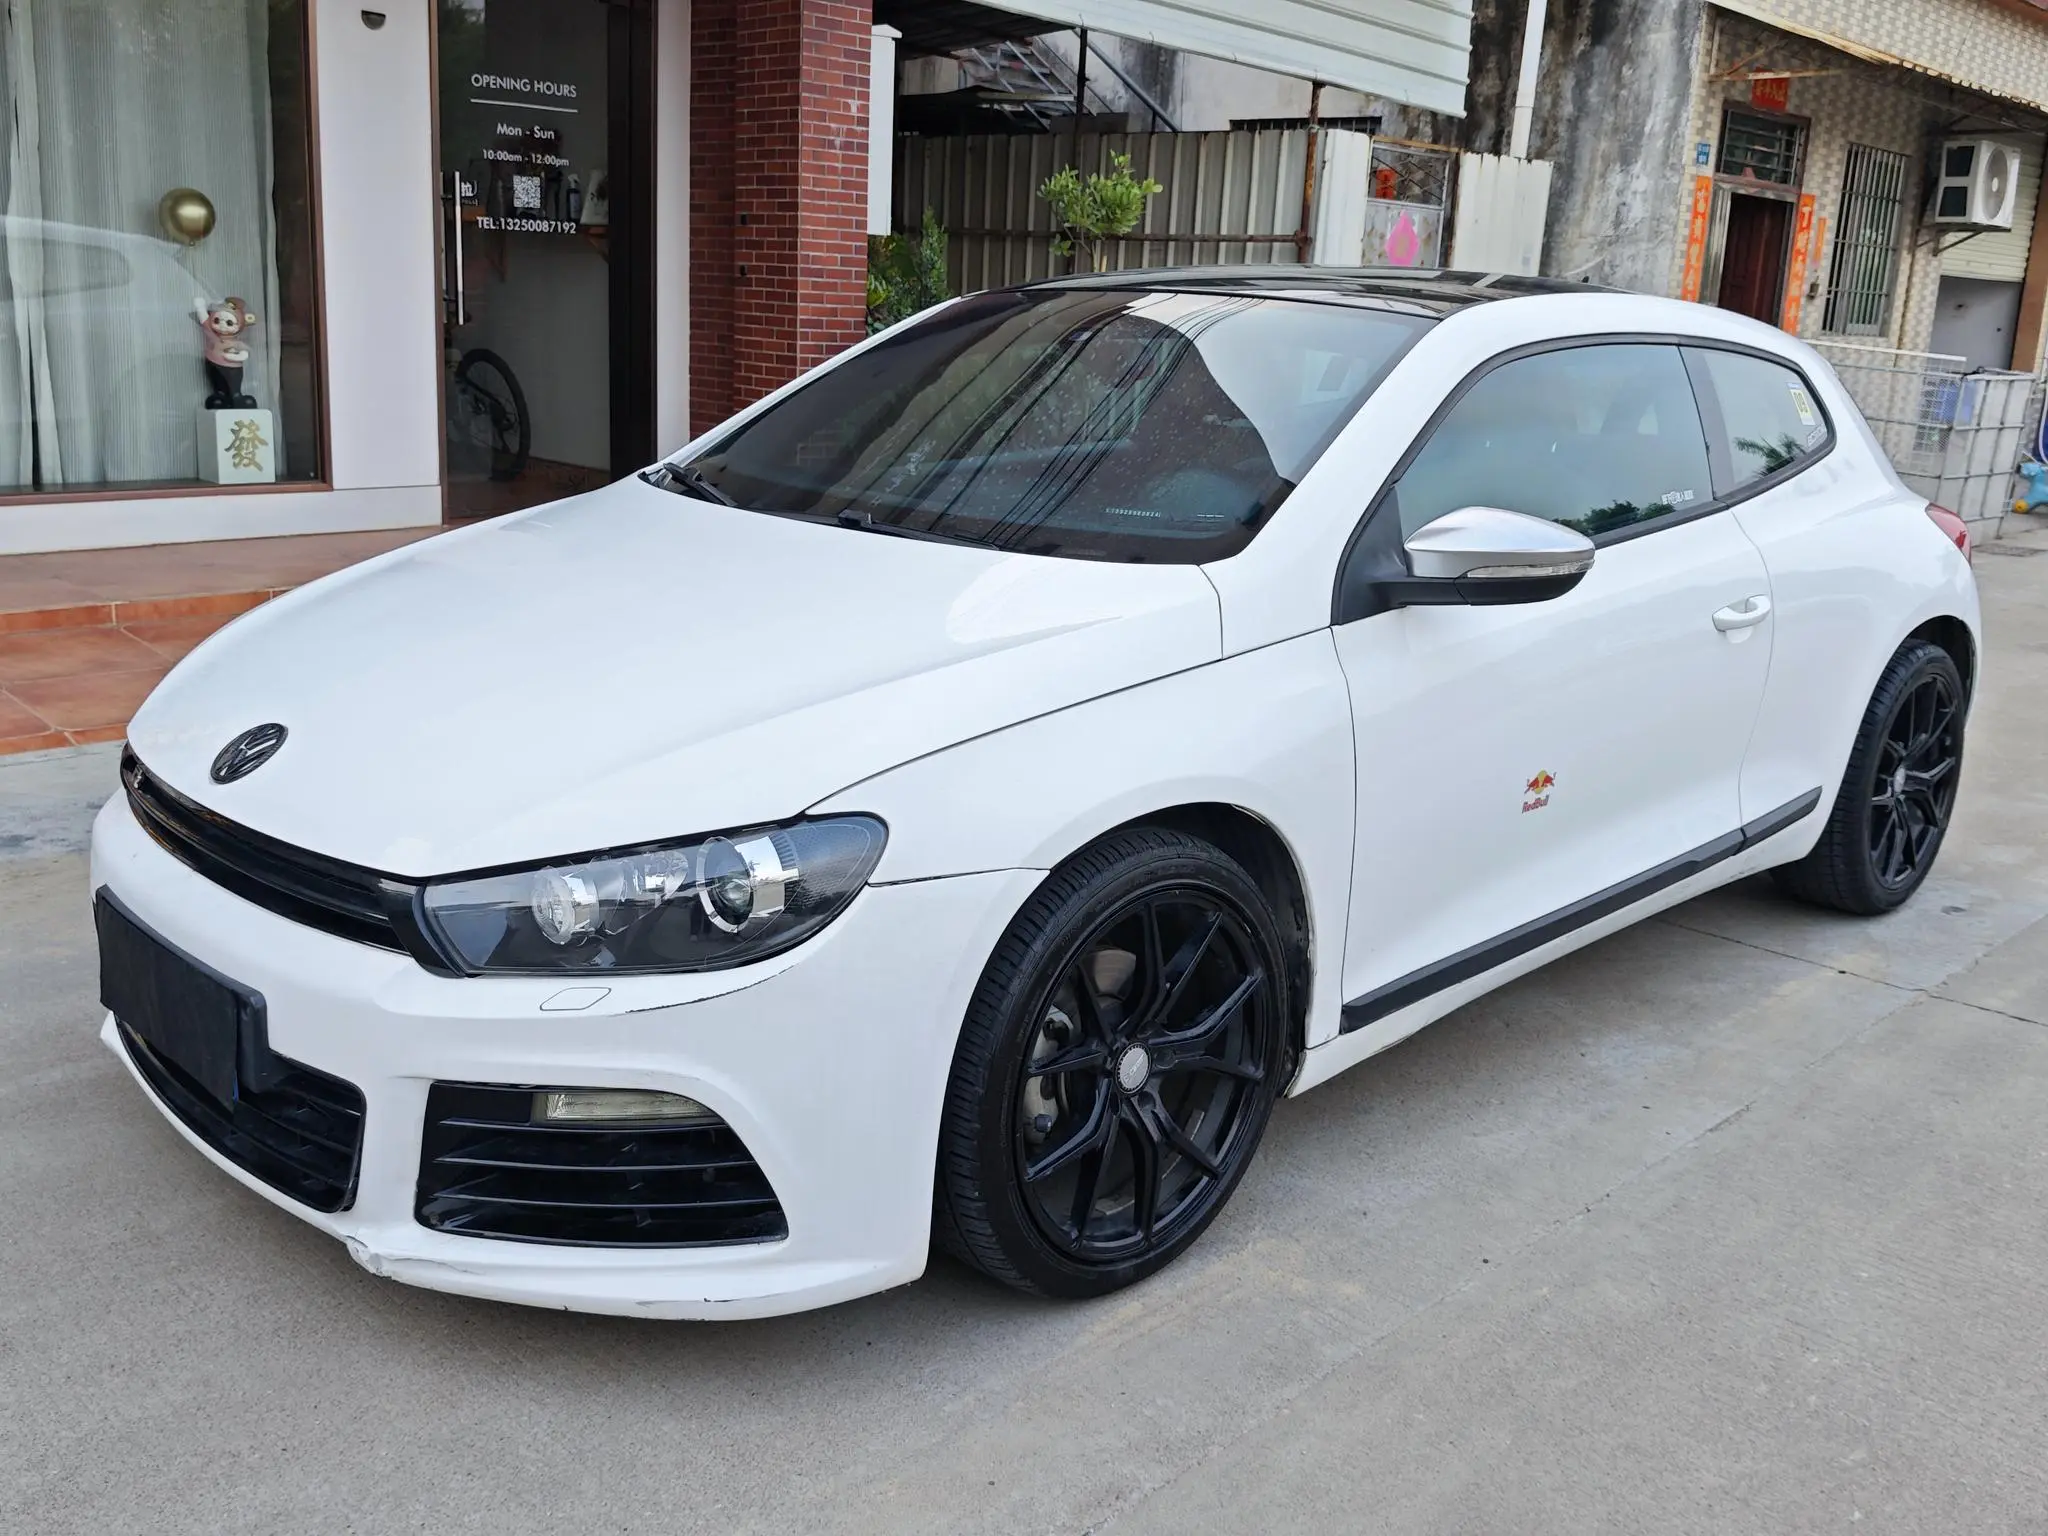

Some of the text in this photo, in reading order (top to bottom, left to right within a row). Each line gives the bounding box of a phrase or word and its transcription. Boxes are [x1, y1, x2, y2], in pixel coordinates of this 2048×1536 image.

[471, 74, 577, 98] OPENING HOURS
[496, 123, 522, 137] Mon
[533, 125, 555, 140] Sun
[482, 149, 522, 163] 10:00am
[531, 153, 570, 167] 12:00pm
[477, 216, 577, 234] TEL:13250087192
[224, 419, 269, 472] 發
